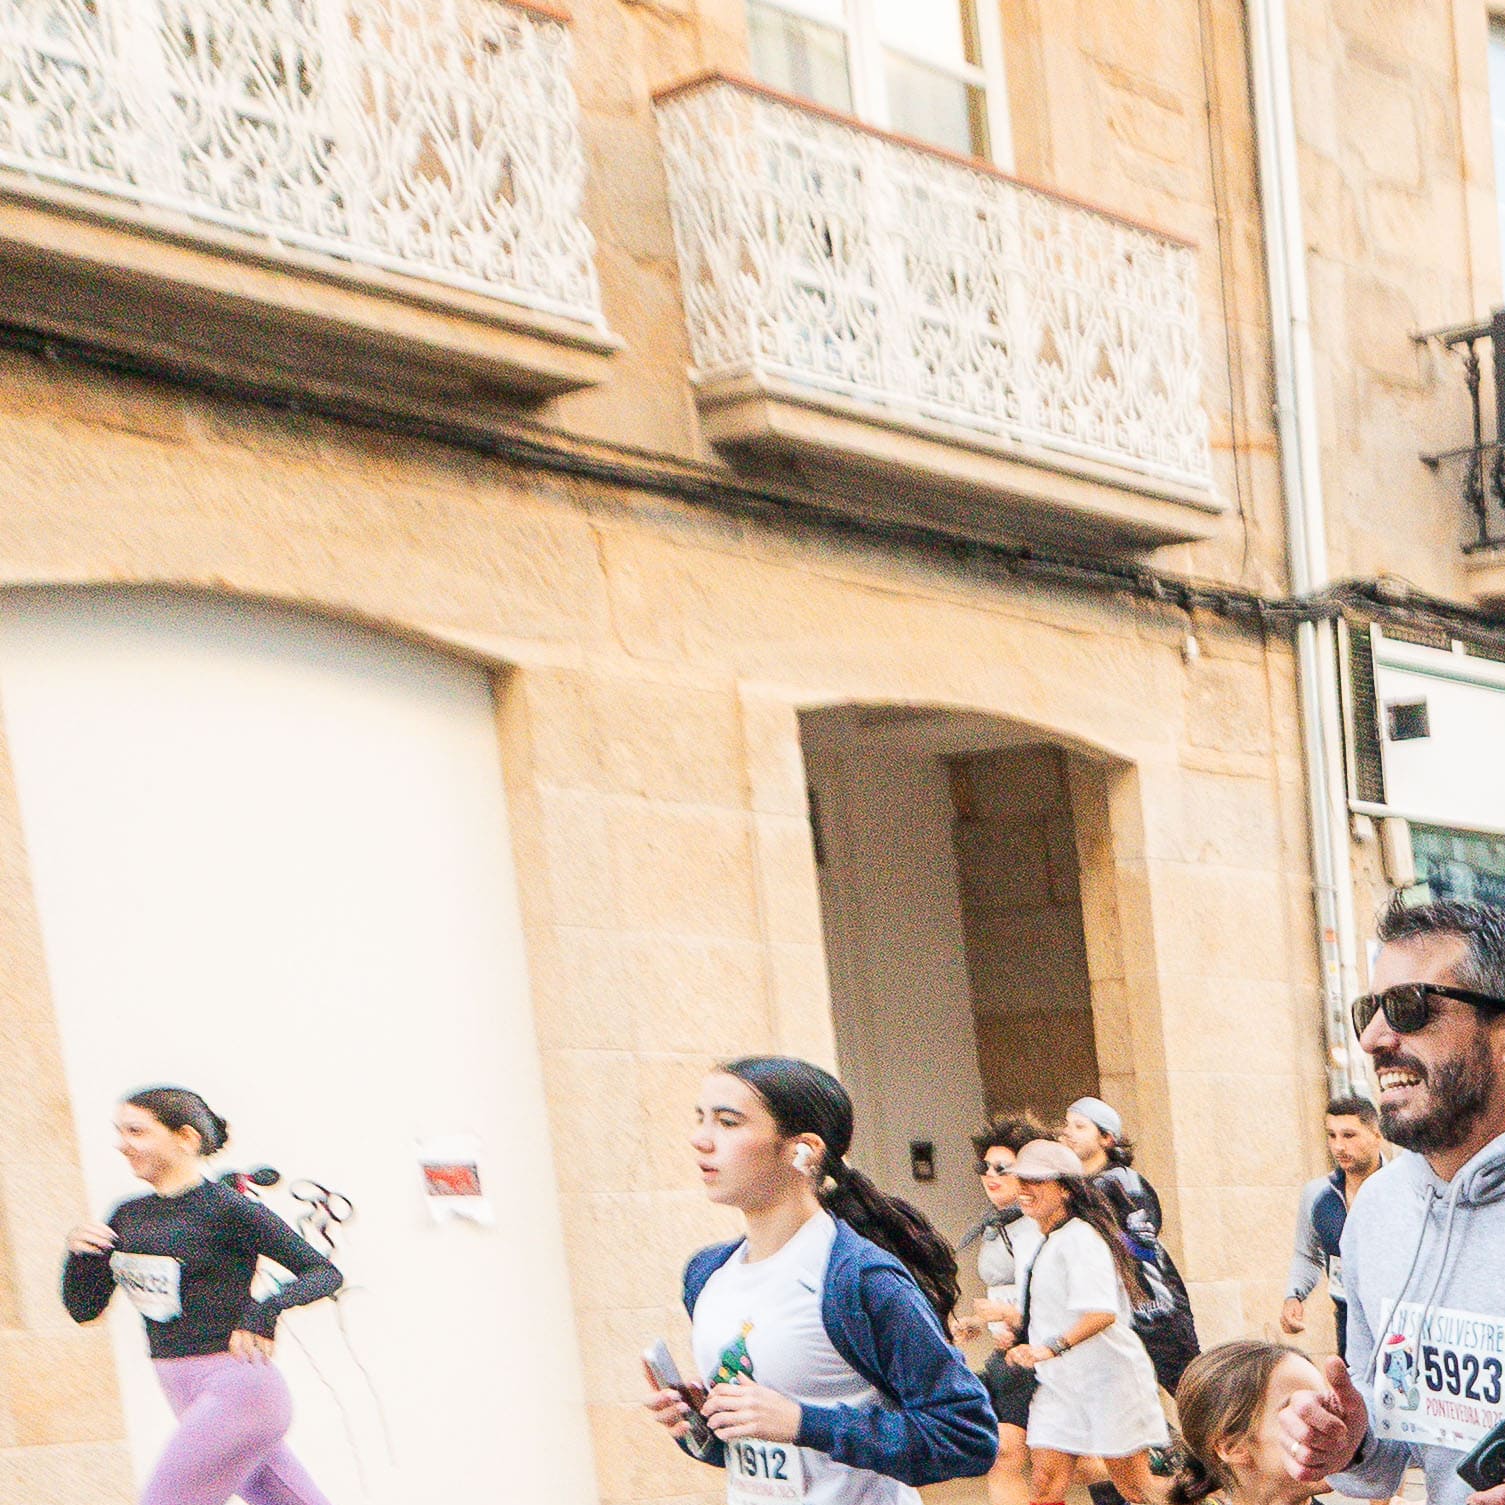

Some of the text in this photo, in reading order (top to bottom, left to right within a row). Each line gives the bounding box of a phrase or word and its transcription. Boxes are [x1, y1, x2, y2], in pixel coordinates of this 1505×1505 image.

[1436, 1315, 1505, 1354] SILVESTRE
[1422, 1344, 1503, 1405] 5923
[1425, 1397, 1481, 1427] PONTEVEDRA
[734, 1443, 788, 1481] 1912
